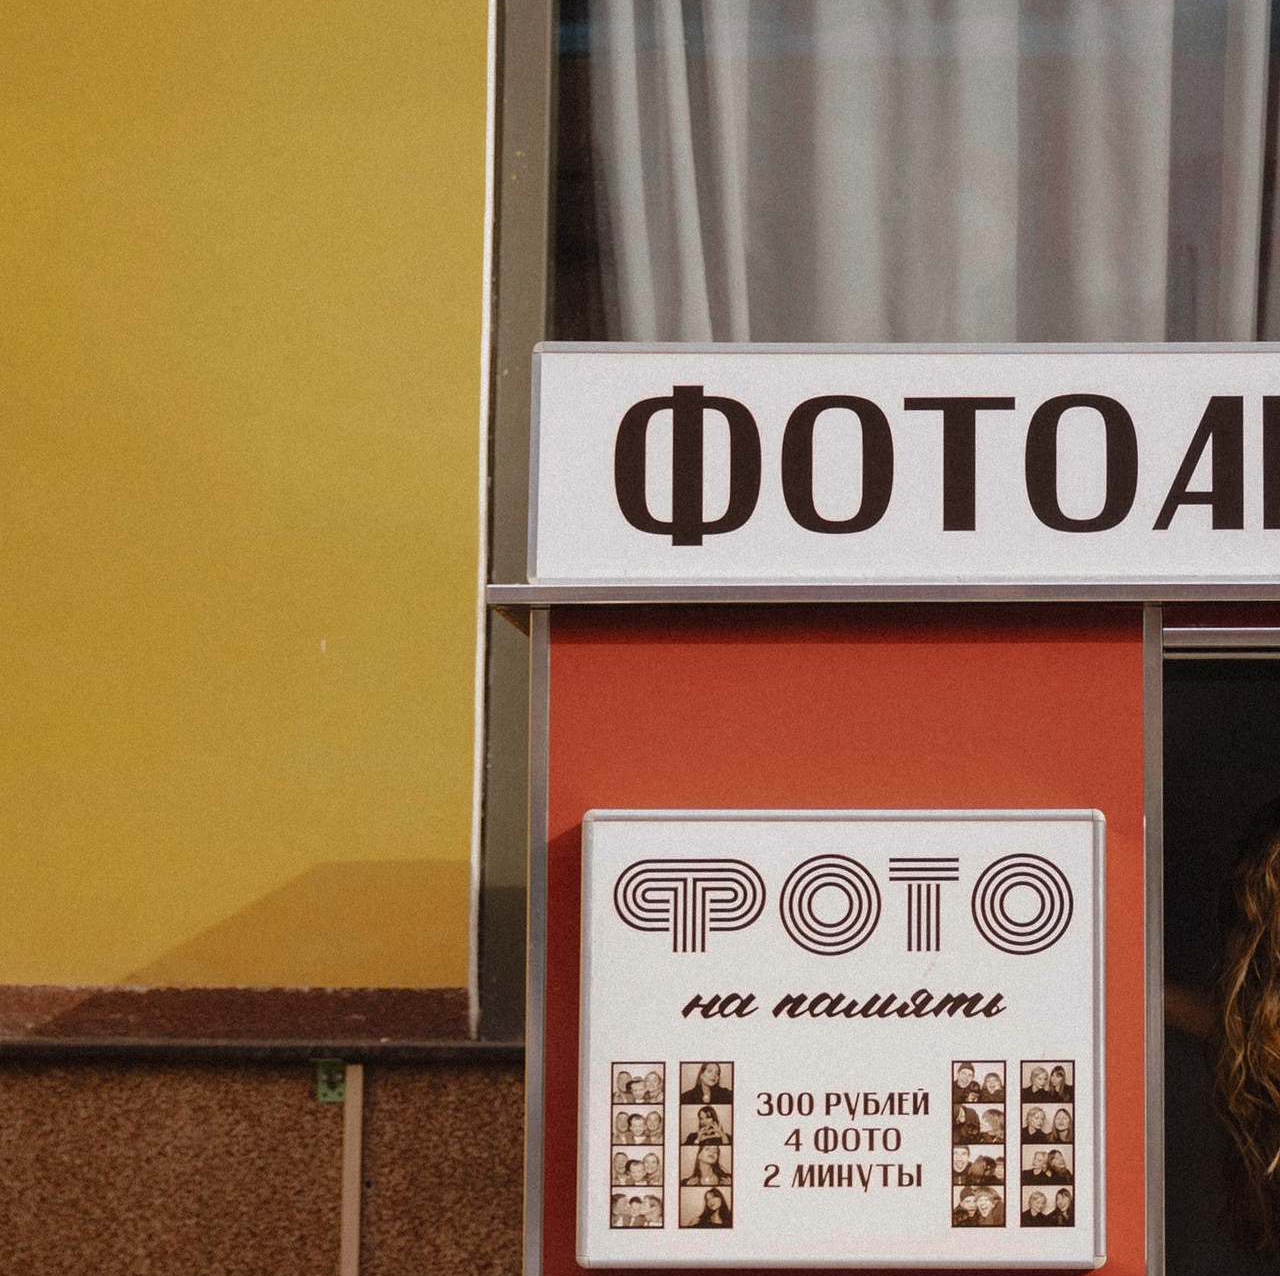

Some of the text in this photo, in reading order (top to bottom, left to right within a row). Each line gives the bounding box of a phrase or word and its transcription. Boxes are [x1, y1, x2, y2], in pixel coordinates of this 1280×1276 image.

[613, 852, 1075, 957] ФОТО
[681, 988, 1007, 1020] на память
[757, 1088, 930, 1122] 300 РУБЛЕЙ
[784, 1126, 902, 1155] 4 ФОТО
[763, 1164, 924, 1193] 2 МИНУТЫ
